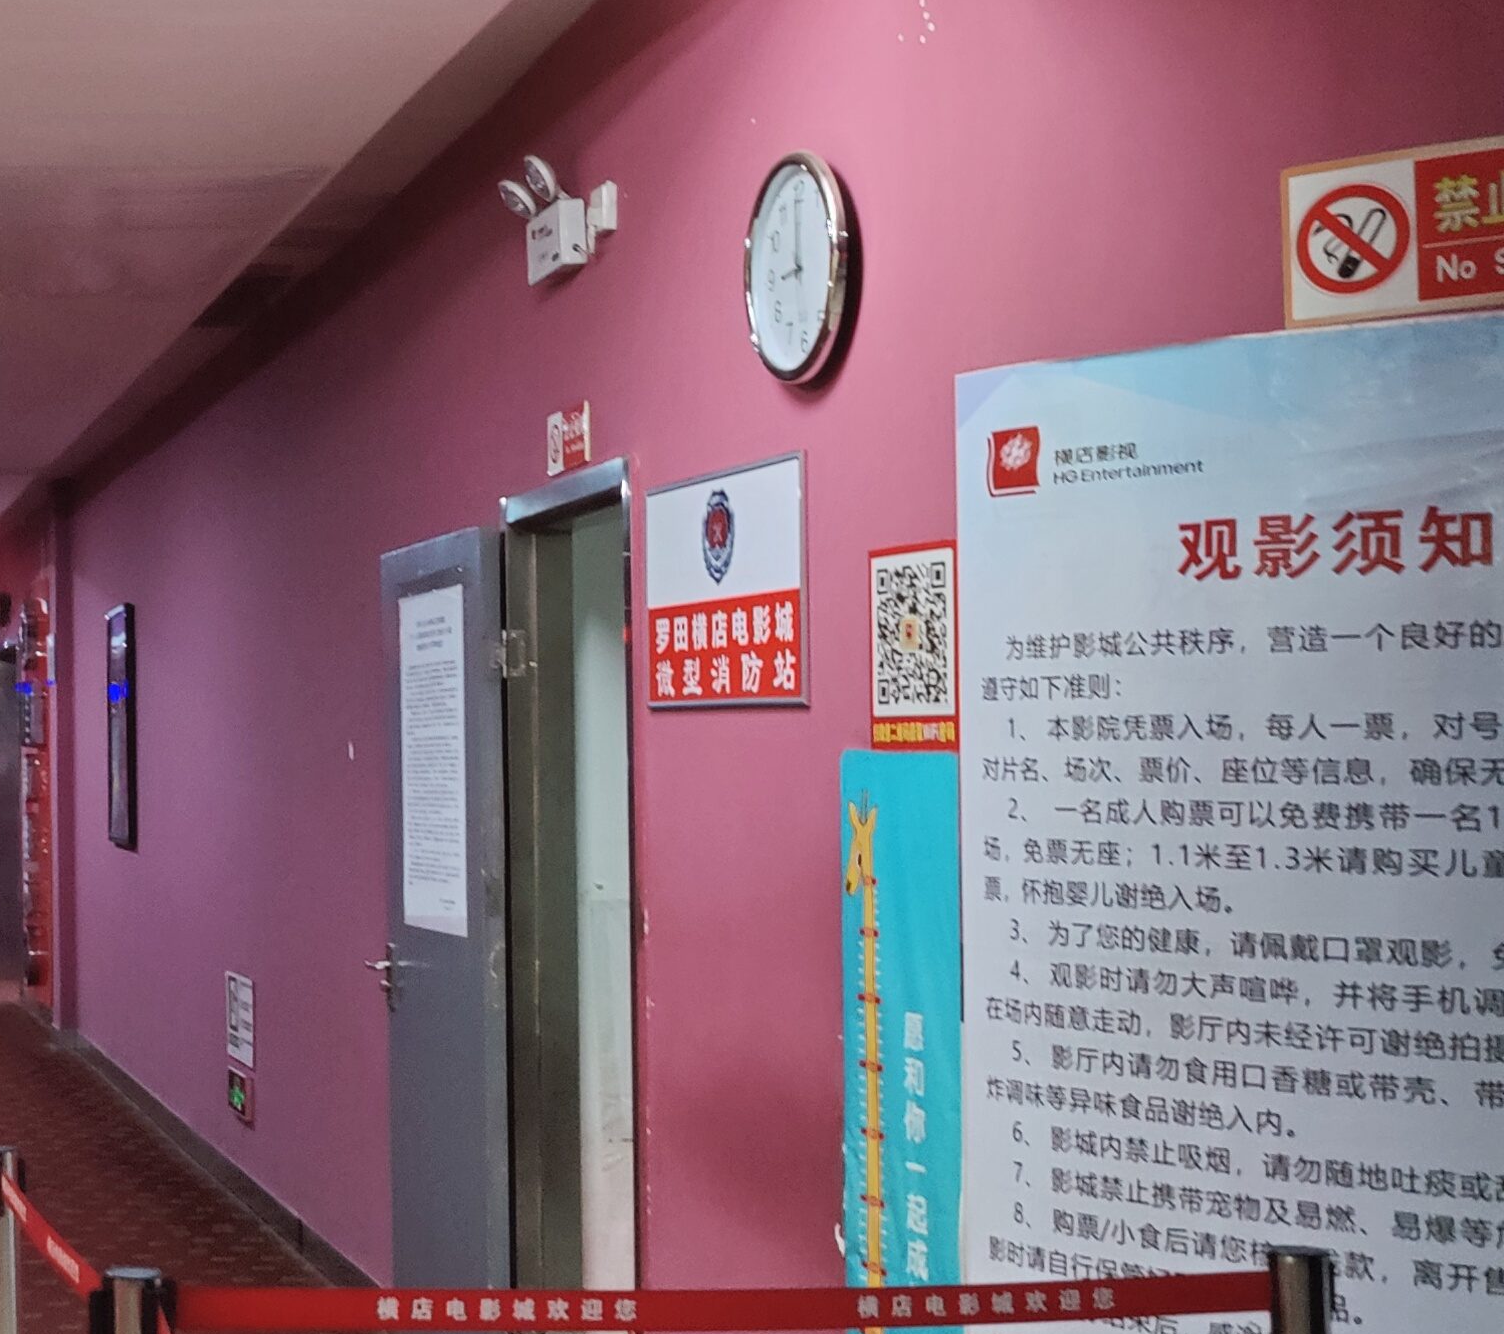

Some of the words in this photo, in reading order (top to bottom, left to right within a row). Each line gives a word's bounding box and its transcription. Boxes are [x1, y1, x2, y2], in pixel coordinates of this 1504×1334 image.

[1436, 253, 1477, 284] No
[1053, 441, 1138, 466] 横店影视
[1053, 466, 1079, 485] HG
[1080, 458, 1205, 483] Entertainment
[1177, 505, 1494, 581] 观影须知
[655, 601, 795, 655] 罗田横店电影城
[655, 647, 796, 699] 微型消防站
[1011, 1120, 1504, 1202] 6、影城内禁止吸烟，请勿随地吐痰或
[1013, 1161, 1504, 1249] 7、影城禁止携带宠物及易燃、易爆等
[376, 1295, 638, 1322] 横店电影城欢迎您
[857, 1286, 1116, 1320] 横店电影城欢迎您
